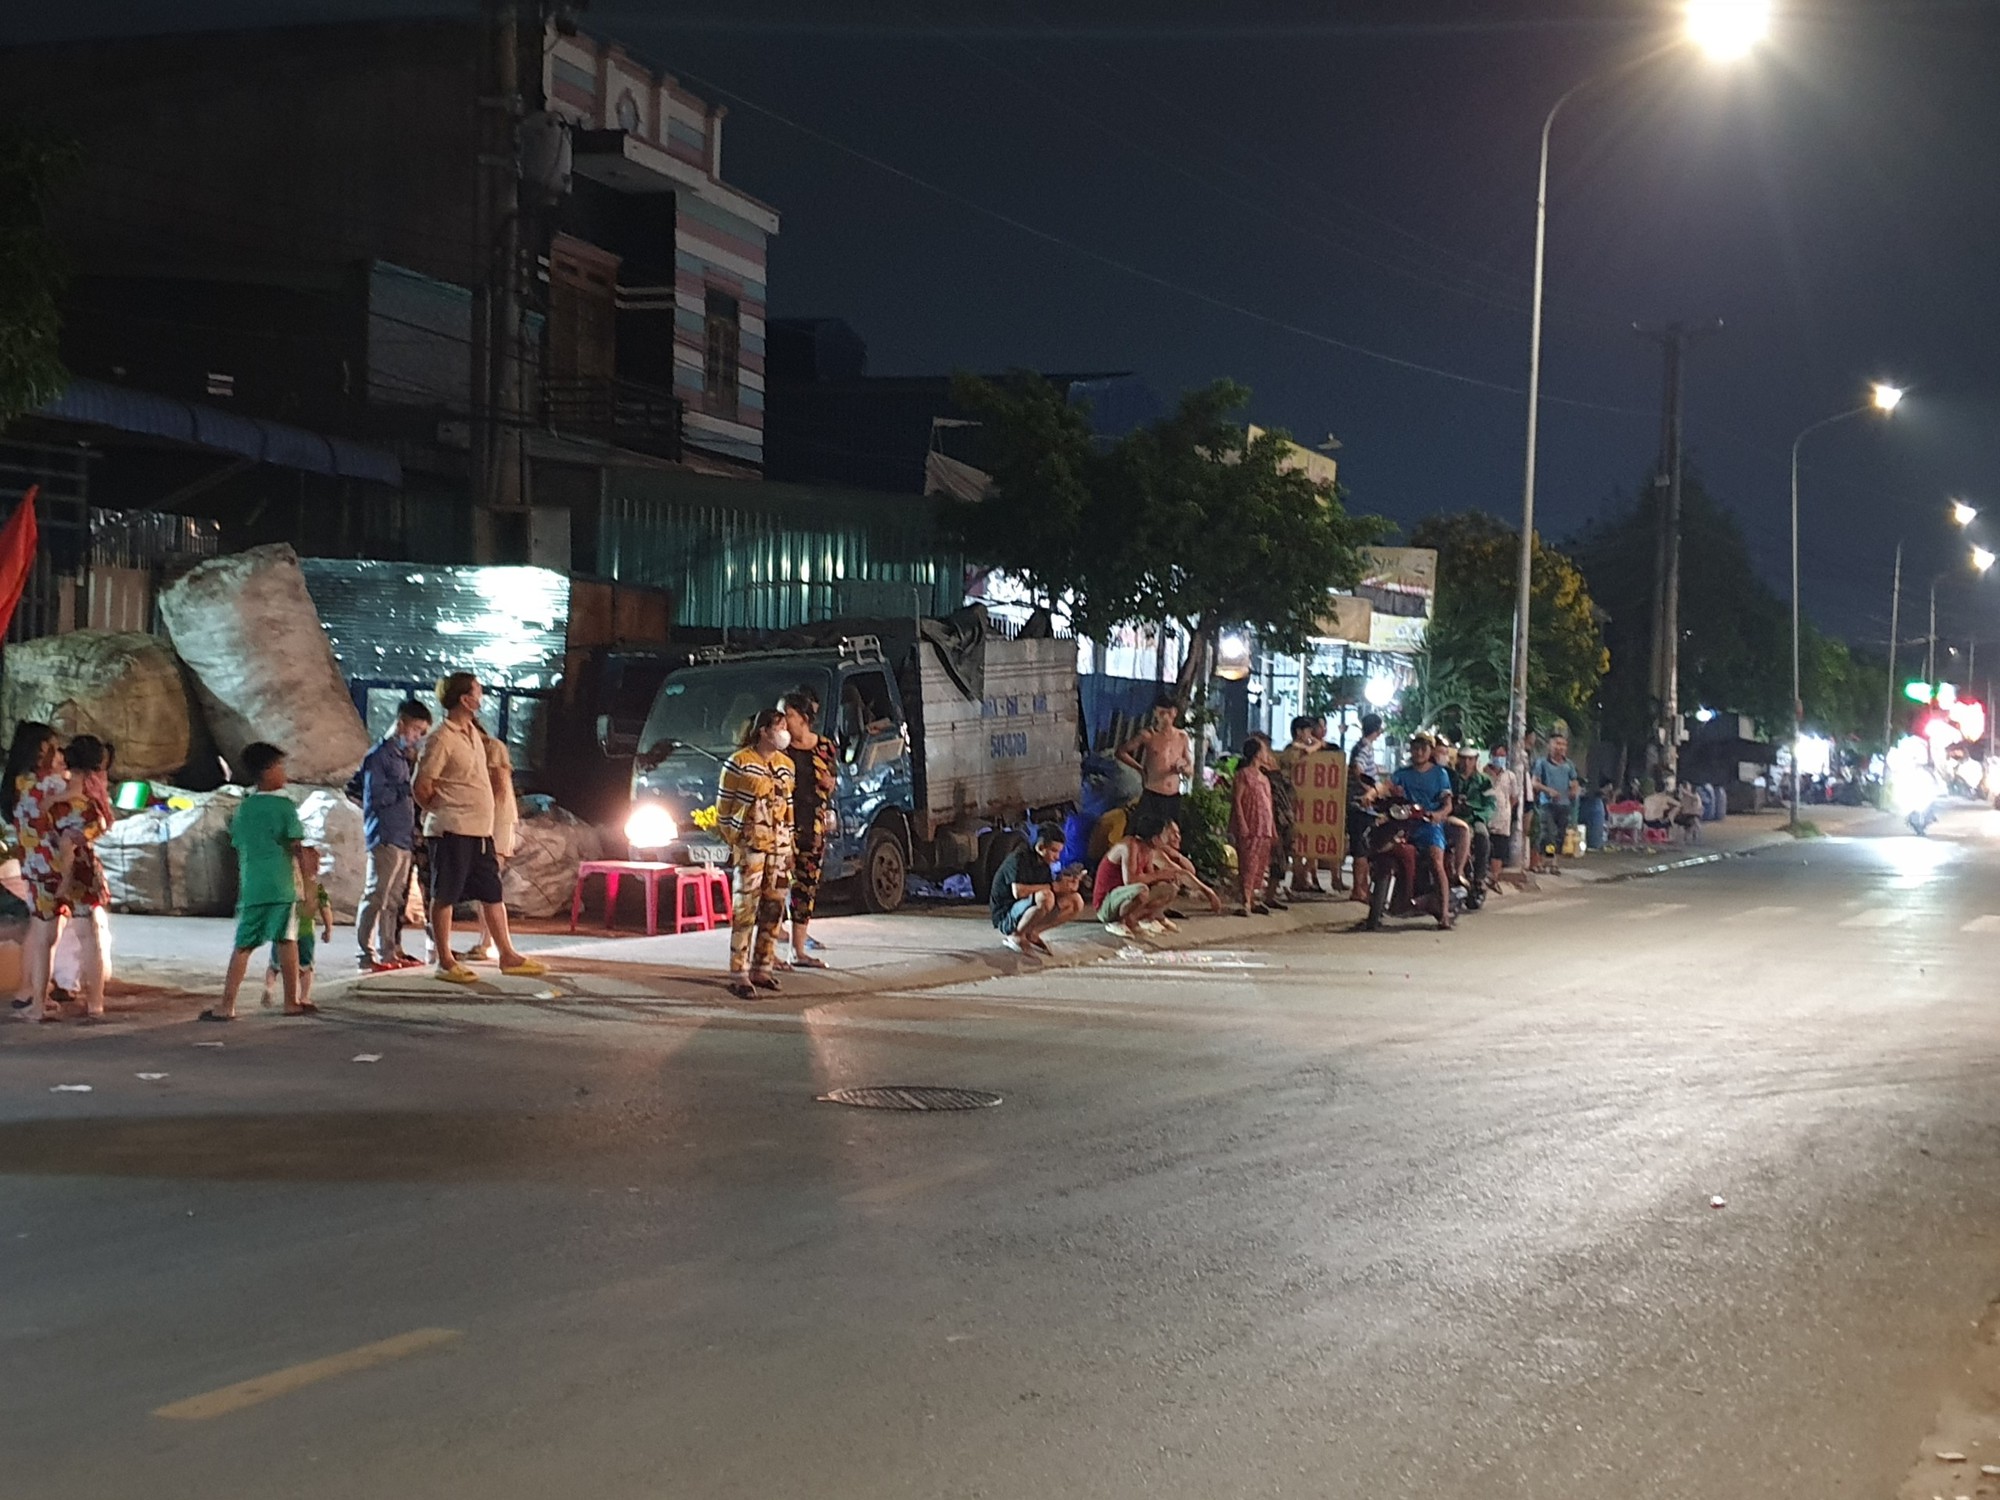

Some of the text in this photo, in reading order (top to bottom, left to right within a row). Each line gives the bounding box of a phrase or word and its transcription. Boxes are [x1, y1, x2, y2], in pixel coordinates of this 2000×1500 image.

[1314, 758, 1339, 789] BÒ
[1312, 794, 1337, 826] BÒ
[1314, 831, 1337, 855] GÀ
